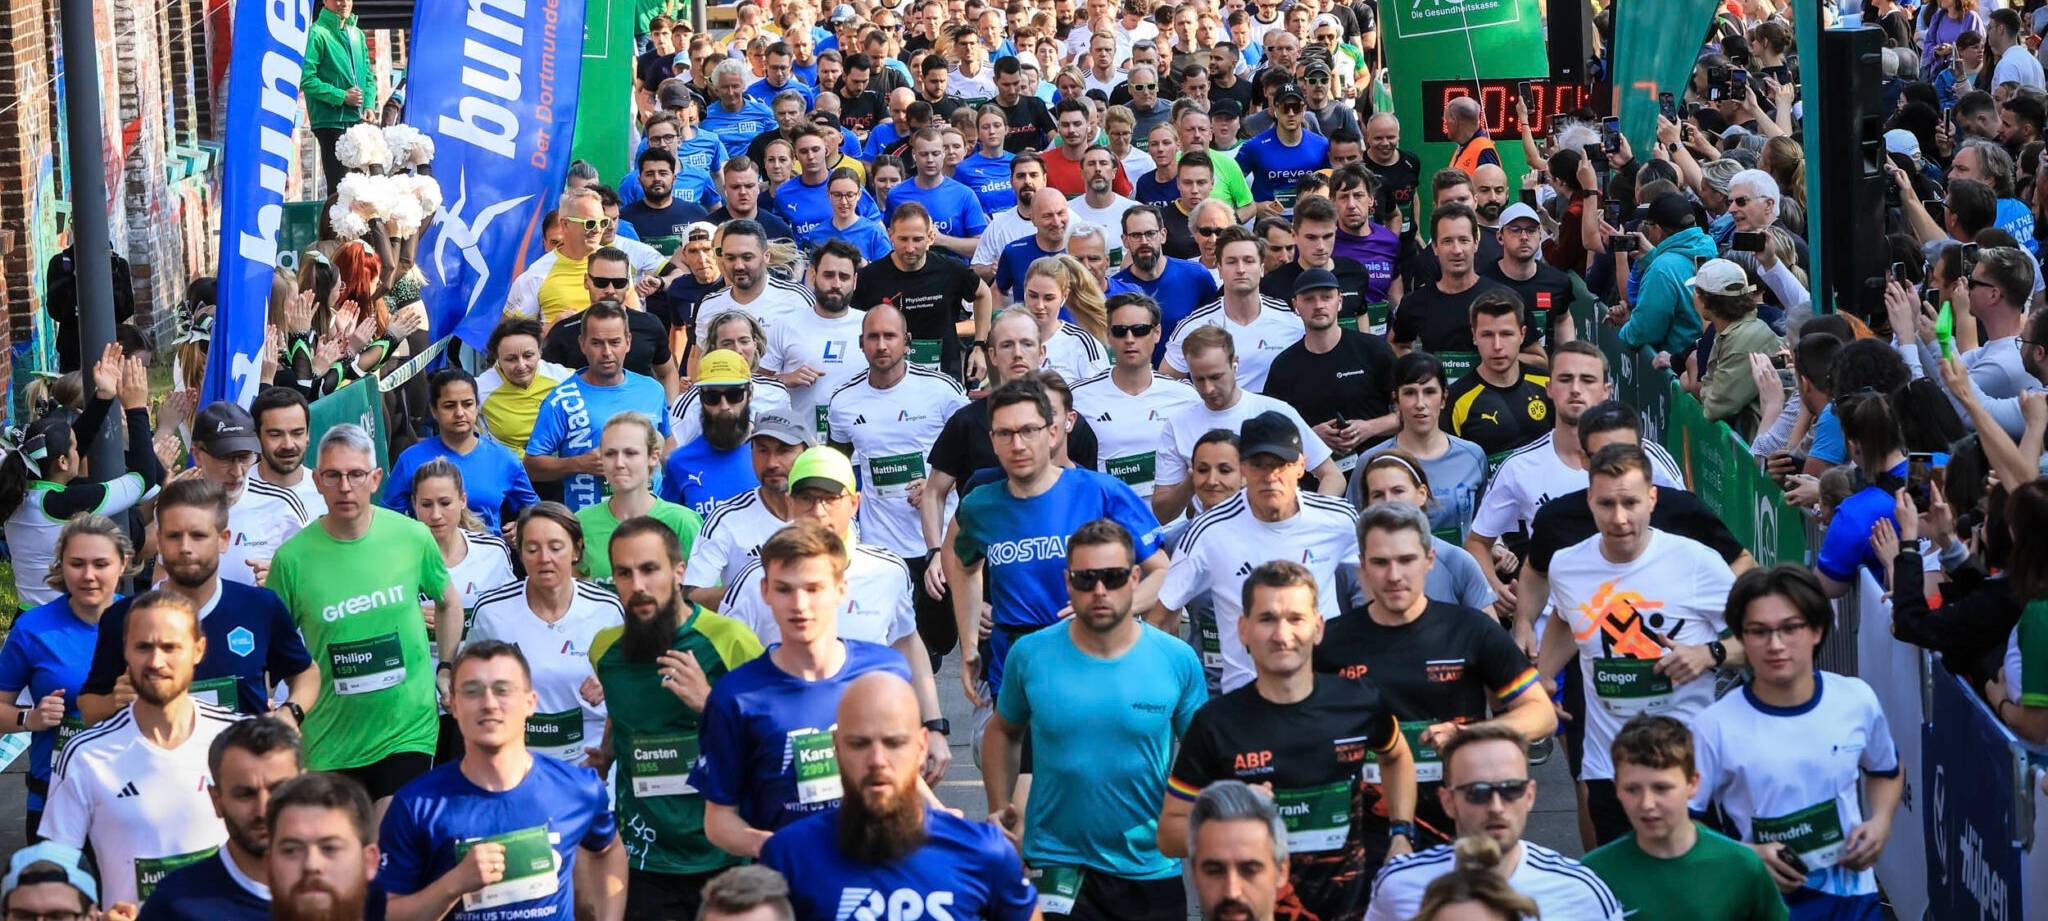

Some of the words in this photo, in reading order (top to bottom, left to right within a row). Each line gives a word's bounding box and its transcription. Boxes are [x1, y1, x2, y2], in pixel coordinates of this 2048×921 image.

[1411, 11, 1423, 19] Die
[530, 129, 549, 169] Der
[1442, 360, 1470, 369] ndreas
[552, 381, 593, 448] Nach
[872, 463, 908, 475] Matthias
[1110, 464, 1141, 477] Michel
[987, 535, 1071, 567] KOSTA
[388, 583, 405, 603] IT
[333, 650, 373, 665] Philipp
[1597, 671, 1638, 684] Gregor
[525, 723, 559, 733] laudia
[634, 747, 678, 760] Carsten
[1234, 750, 1273, 769] ABP
[1758, 823, 1813, 843] Hendrik
